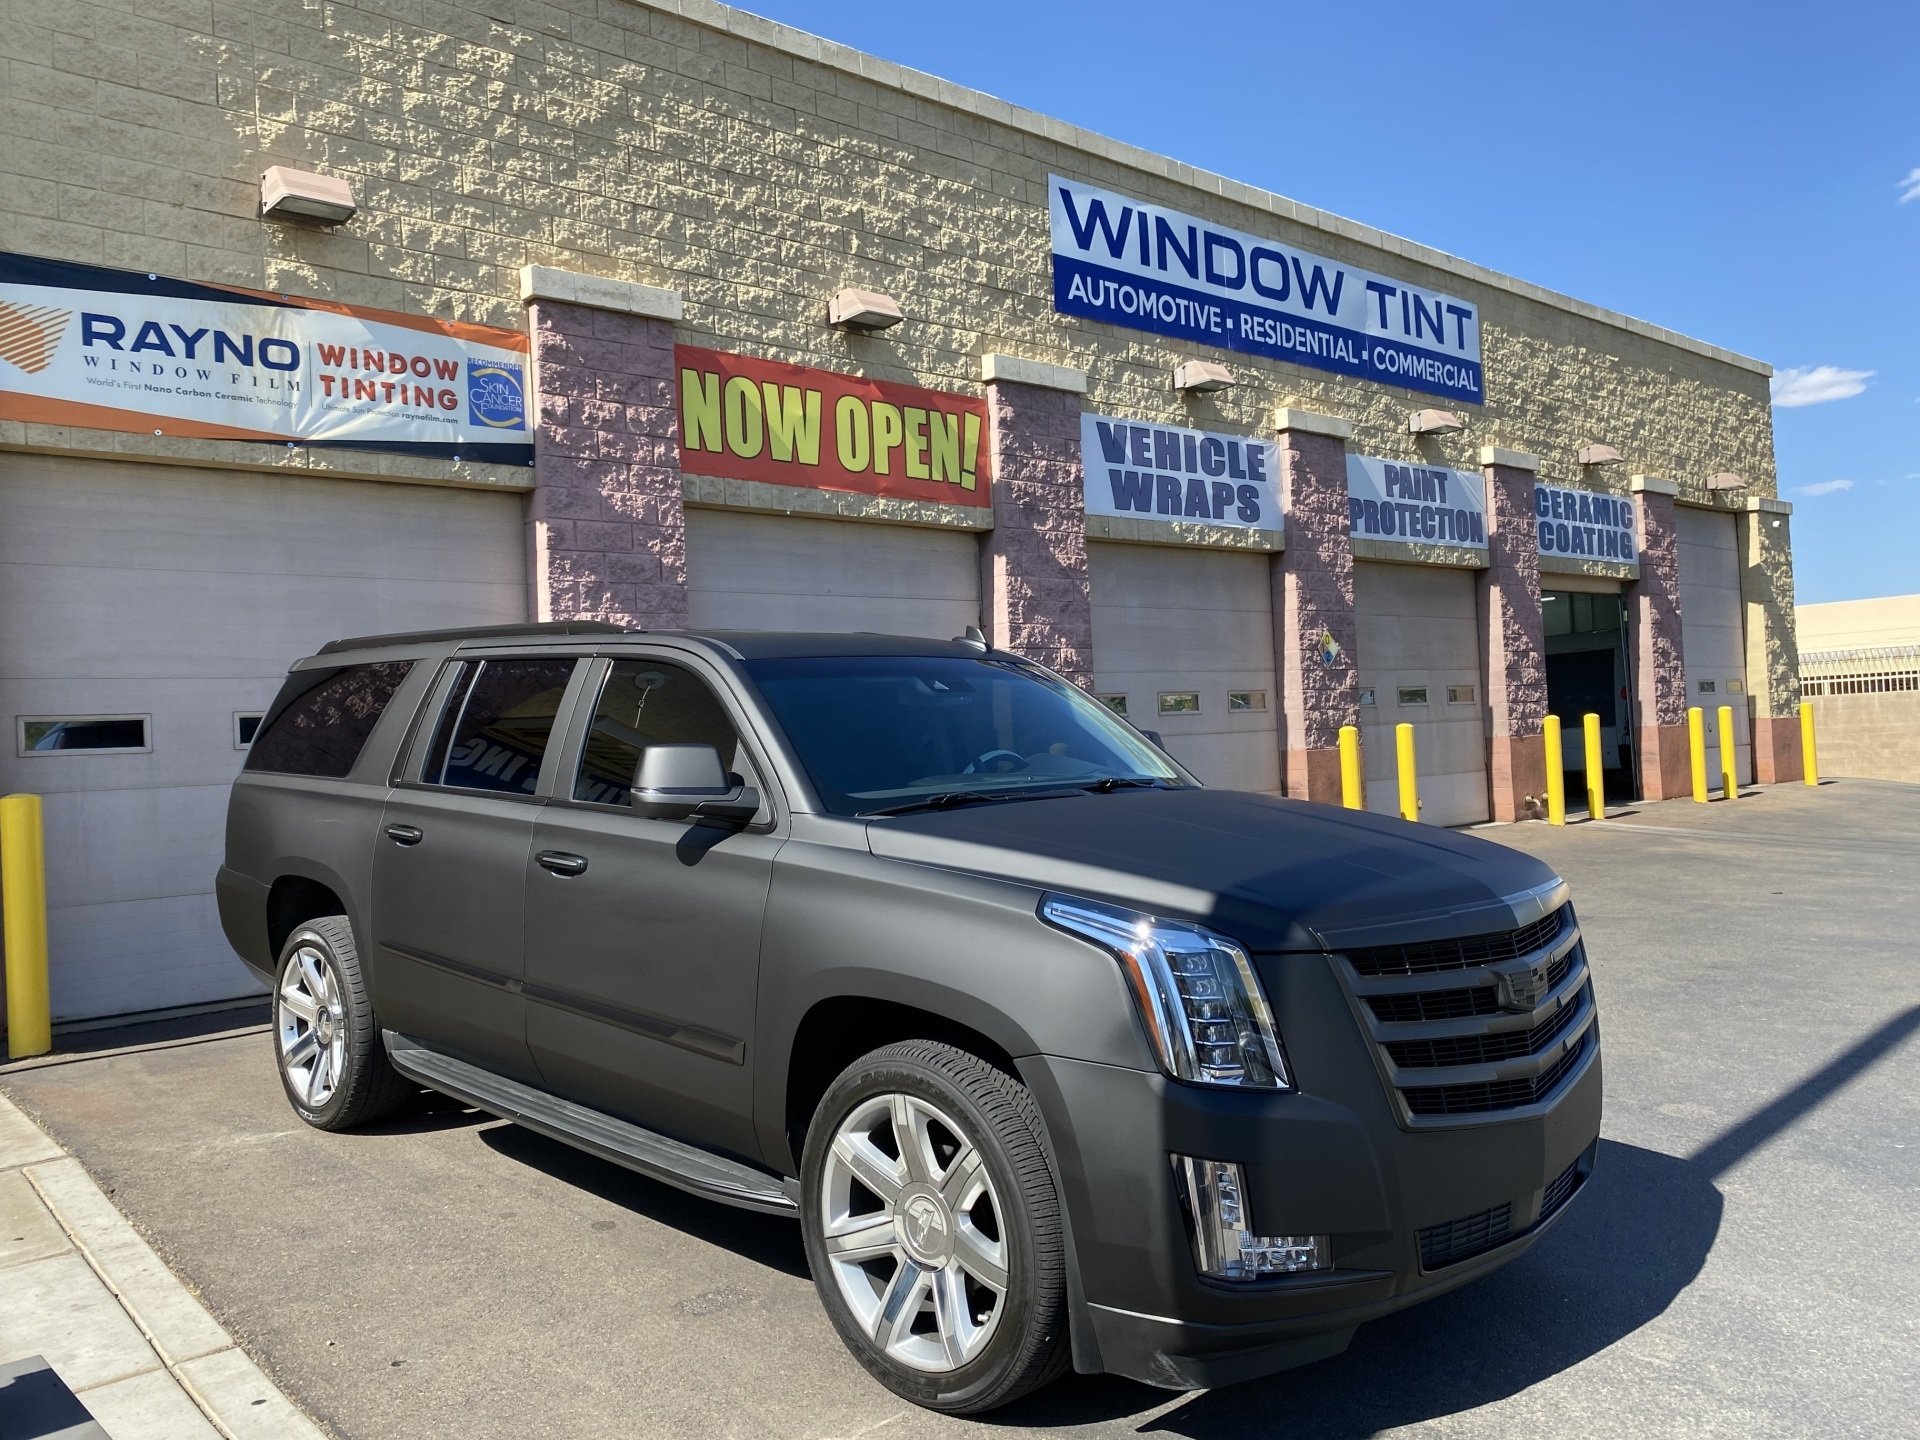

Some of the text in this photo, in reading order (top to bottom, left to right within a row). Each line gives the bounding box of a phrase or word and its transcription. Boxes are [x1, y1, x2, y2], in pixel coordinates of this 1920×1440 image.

[1058, 186, 1473, 351] WINDOW TINT
[81, 312, 300, 371] RAYNO
[1068, 273, 1479, 393] AUTOMOTIVE RESIDENTIAL COMMERCIAL
[83, 355, 300, 392] WINDOW FILM
[317, 342, 460, 382] WINDOW
[468, 357, 523, 370] RECOMMENDED
[86, 377, 298, 409] World's First Nano Carbon Ceramic Technology
[319, 374, 459, 411] TINTING
[470, 388, 522, 407] CANCER
[480, 378, 509, 395] SKIN
[352, 407, 365, 415] Sun
[401, 413, 459, 424] raynofilm.com
[480, 402, 522, 414] FOUNDATION
[680, 368, 981, 492] NOW OPEN!
[1096, 421, 1267, 482] VEHICLE
[1108, 469, 1261, 523] WRAPS
[1383, 464, 1448, 504] PAINT
[1349, 498, 1484, 544] PROTECTION
[1535, 487, 1633, 530] CERAMIC
[1538, 521, 1633, 560] COATING
